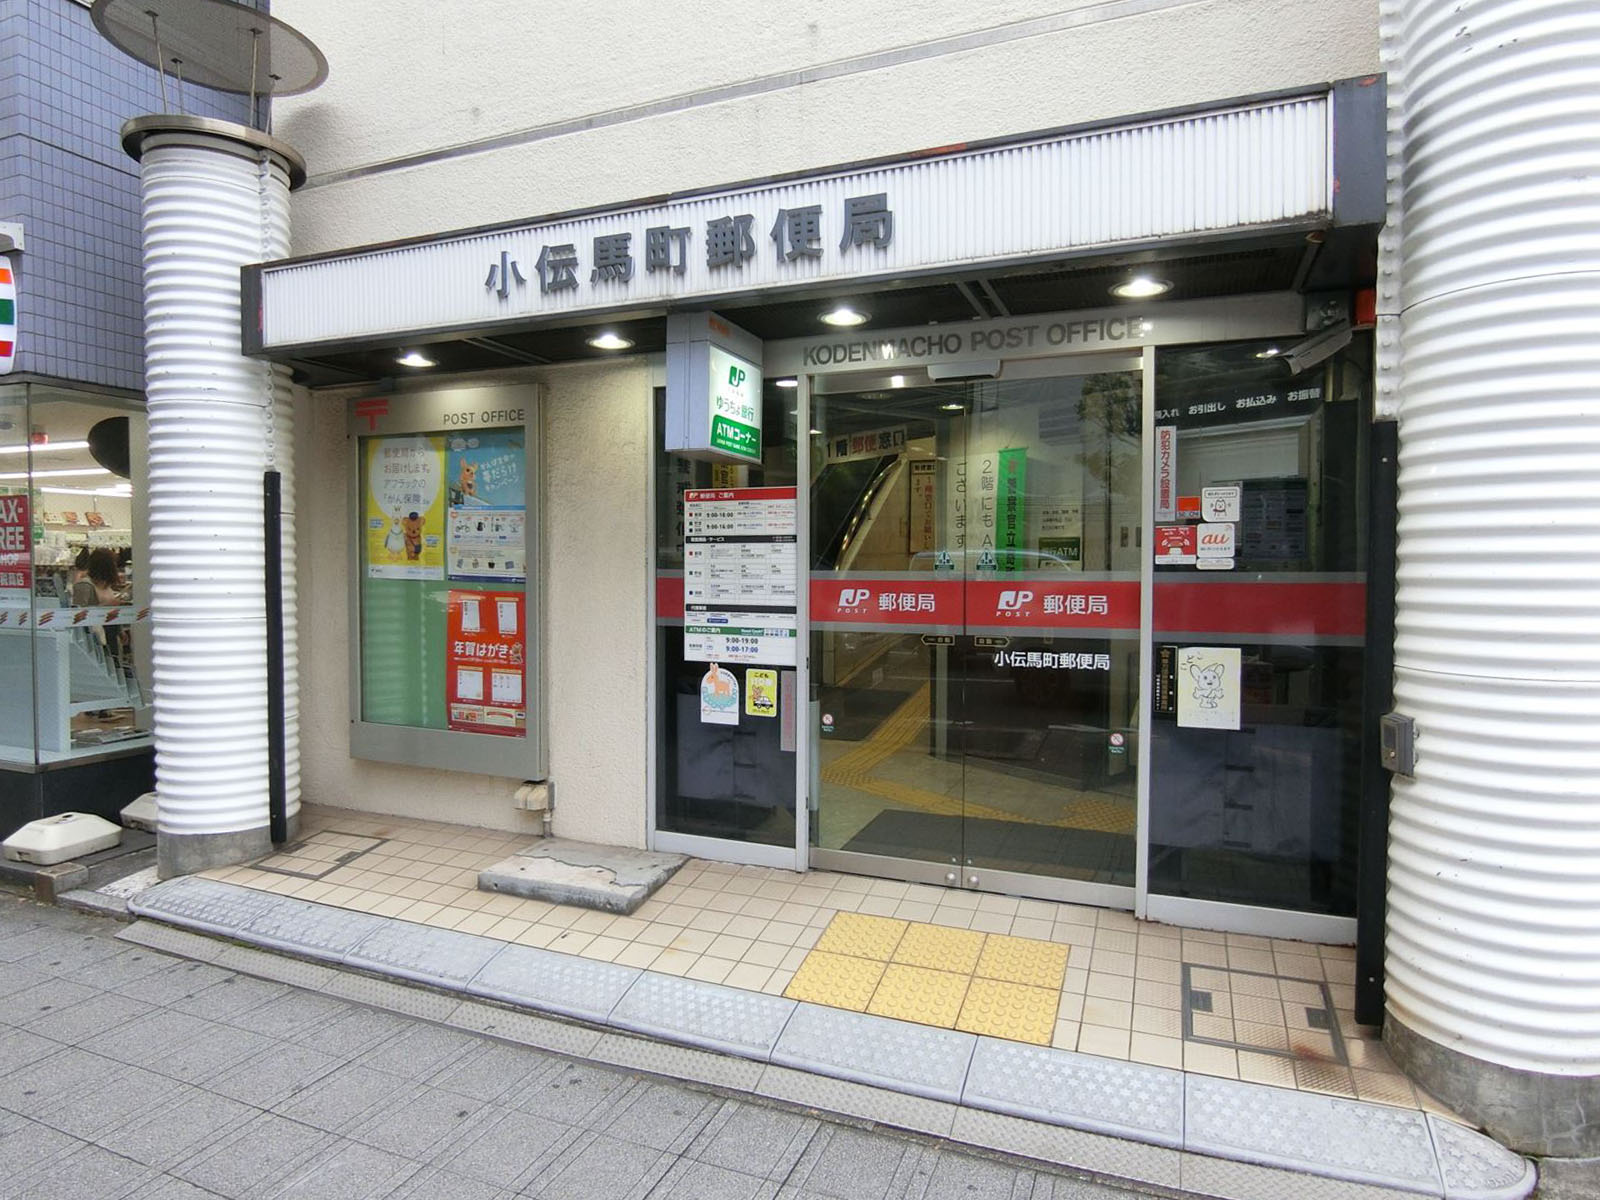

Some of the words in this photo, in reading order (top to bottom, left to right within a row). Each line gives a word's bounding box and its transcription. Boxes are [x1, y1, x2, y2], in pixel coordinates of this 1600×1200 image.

[484, 192, 893, 298] 小伝馬町郵便局
[802, 333, 962, 367] KODENMACHO
[970, 325, 1039, 351] POST
[1046, 315, 1143, 346] OFFICE
[716, 395, 755, 422] ゆうちょ銀行
[1188, 402, 1226, 416] お引出し
[1235, 393, 1277, 409] お払込み
[1287, 387, 1321, 402] お振替
[443, 412, 475, 425] POST
[481, 409, 525, 423] OFFICE
[716, 422, 757, 444] ATMコーナー
[384, 463, 431, 474] お届けします。
[384, 479, 426, 489] アフラックの
[1202, 533, 1230, 545] au
[879, 592, 936, 613] 郵便局
[1043, 594, 1109, 615] 郵便局
[453, 640, 509, 658] 年賀はがき
[725, 637, 759, 645] 9:00-19:00
[725, 645, 759, 653] 9:00-17:00
[994, 651, 1111, 671] 小伝馬町郵便局
